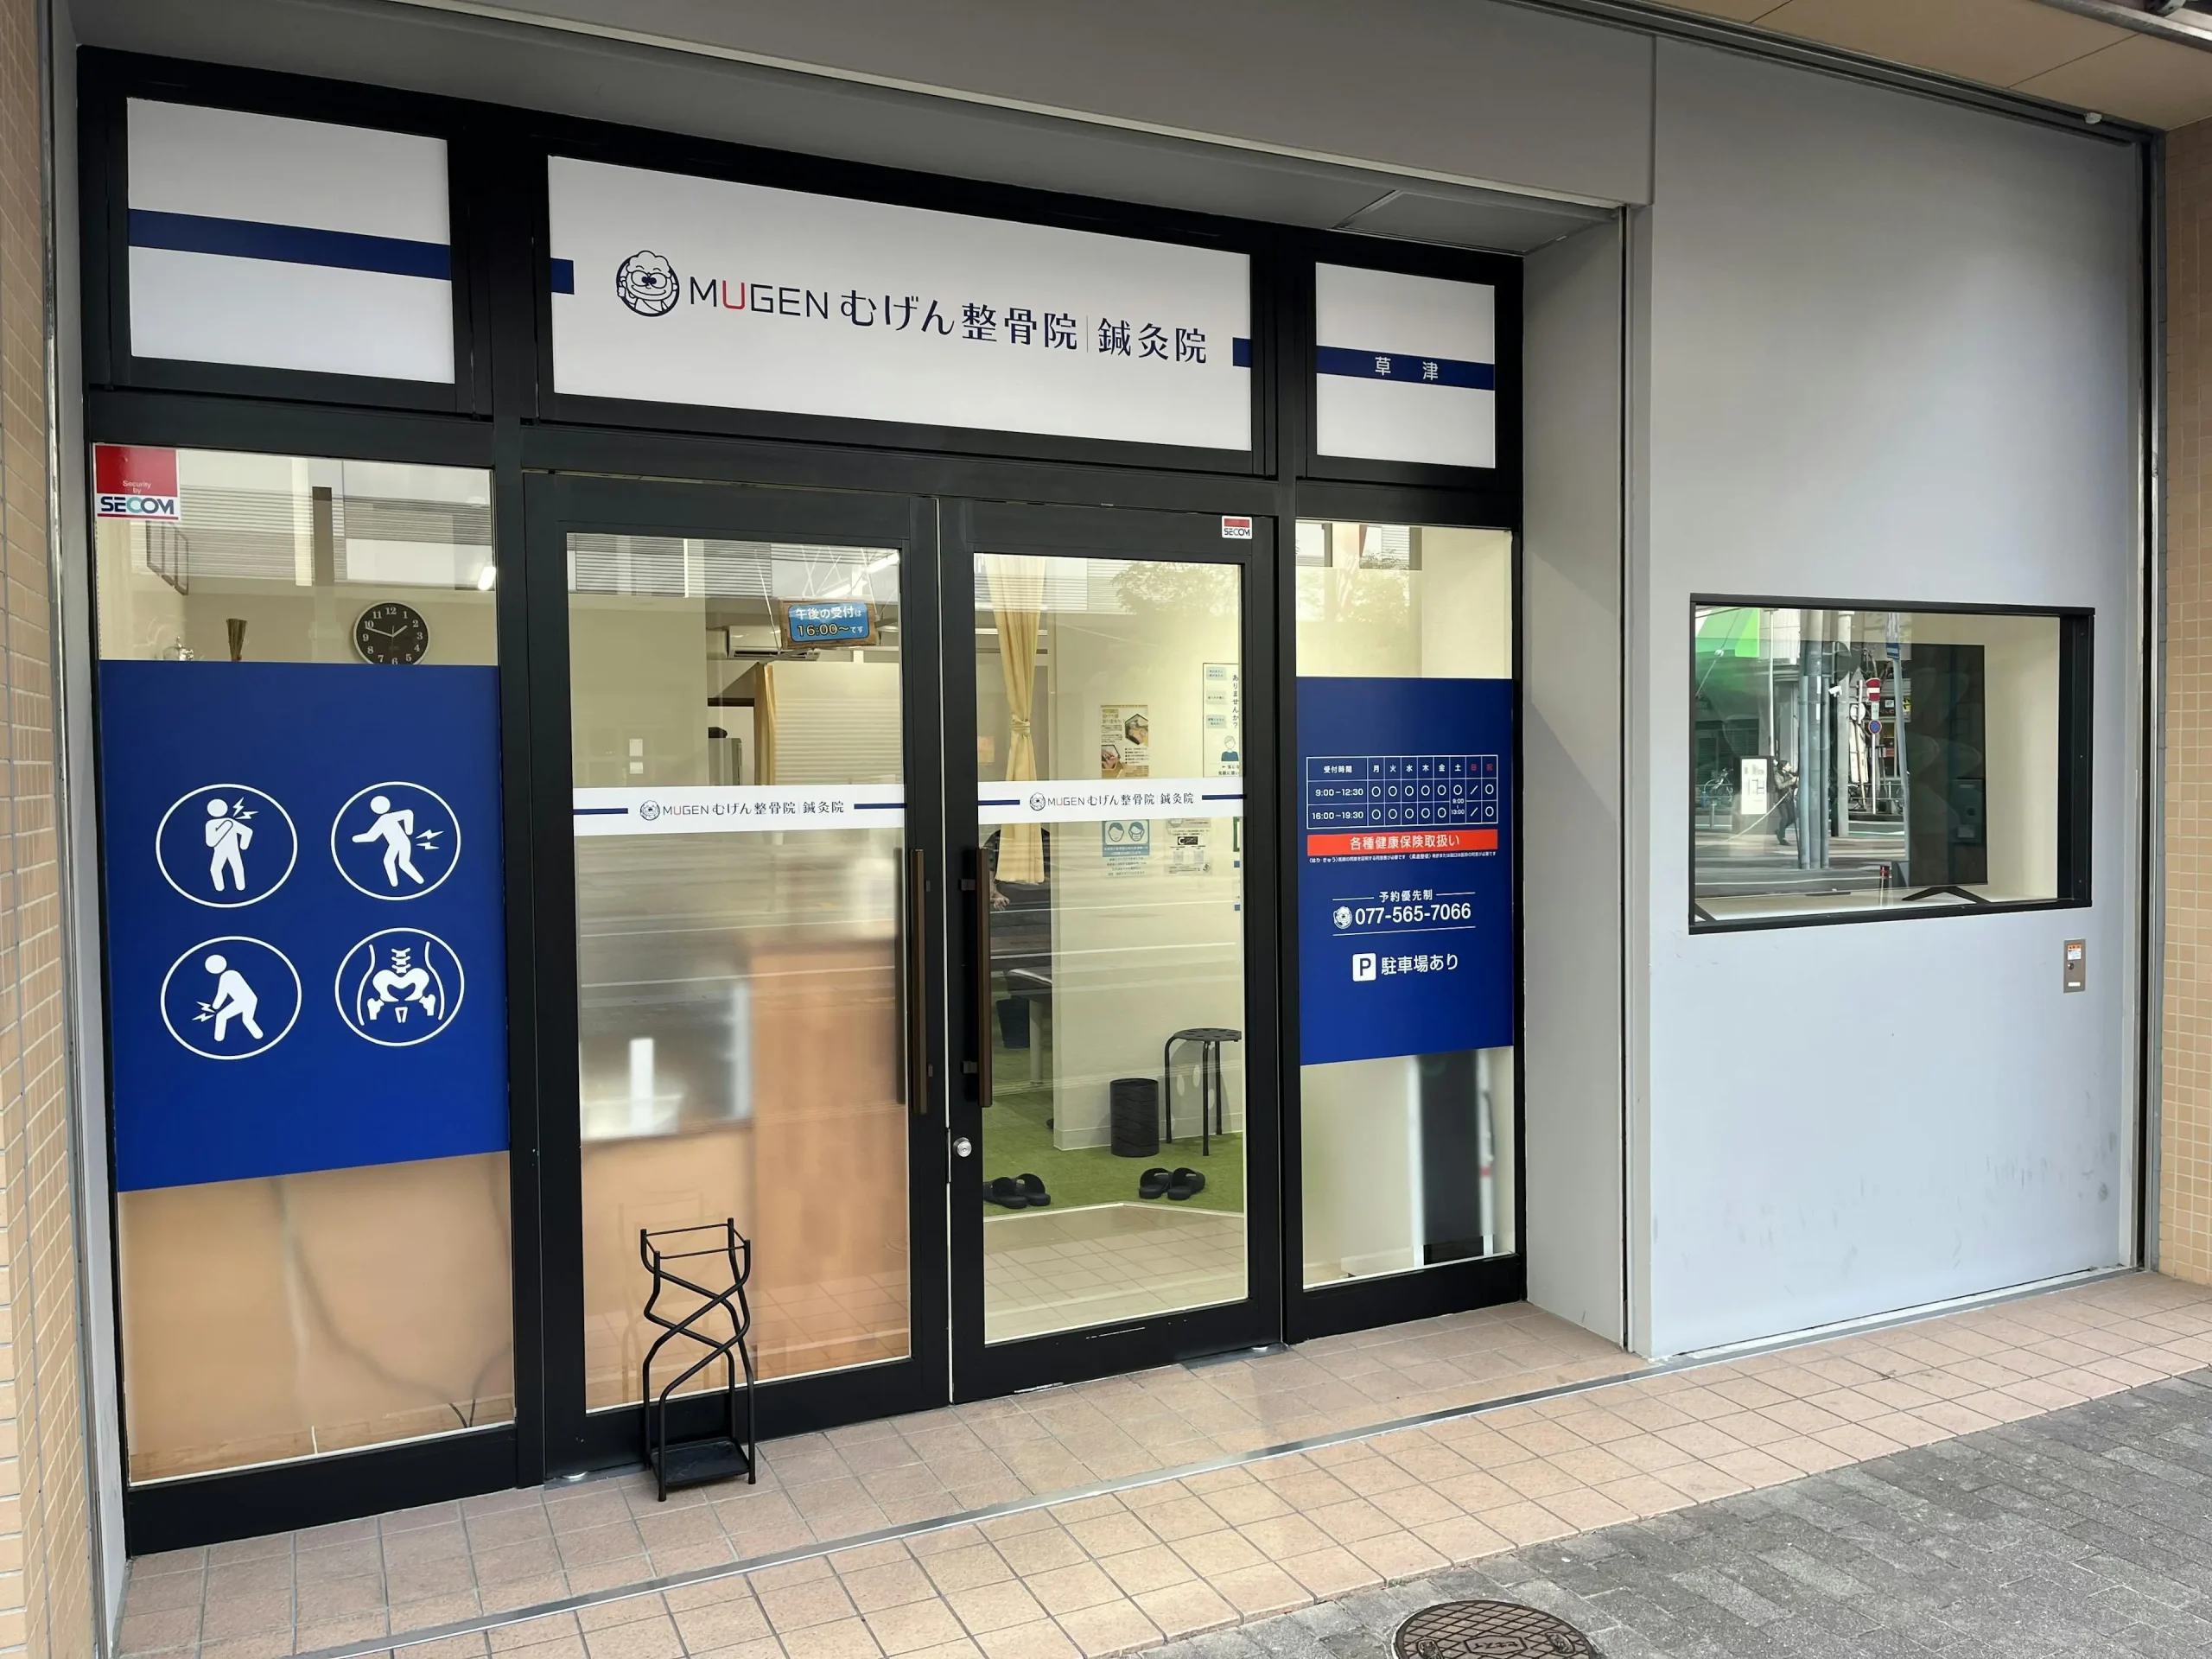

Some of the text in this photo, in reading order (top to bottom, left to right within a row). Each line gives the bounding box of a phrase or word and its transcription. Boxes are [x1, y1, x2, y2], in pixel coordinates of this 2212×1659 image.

[690, 276, 1206, 363] MUGEN むげん整骨院 鍼灸院
[1375, 356, 1439, 380] 草津
[122, 480, 152, 490] Security
[100, 496, 175, 515] SECOM
[372, 611, 383, 620] 11
[385, 607, 397, 615] 12
[403, 611, 409, 620] 1
[795, 606, 862, 620] 午後の受付は
[364, 620, 374, 629] 10
[412, 620, 419, 628] 2
[362, 633, 370, 642] 9
[416, 632, 423, 640] 3
[367, 645, 374, 654] 8
[413, 644, 421, 652] 4
[377, 654, 385, 663] 7
[405, 653, 412, 662] 5
[1323, 765, 1353, 773] 受付時間
[1406, 764, 1413, 772] 水
[1439, 763, 1446, 772] 金
[1047, 792, 1194, 806] MUGEN むげん整骨院 鍼灸院
[663, 800, 844, 816] MUGEN むげん整骨院 鍼灸院
[1350, 834, 1460, 851] 各種健康保険取扱い
[1379, 889, 1433, 903] 予約優先制
[1355, 902, 1471, 925] 077-565-7066
[1381, 953, 1459, 976] 駐車場あり
